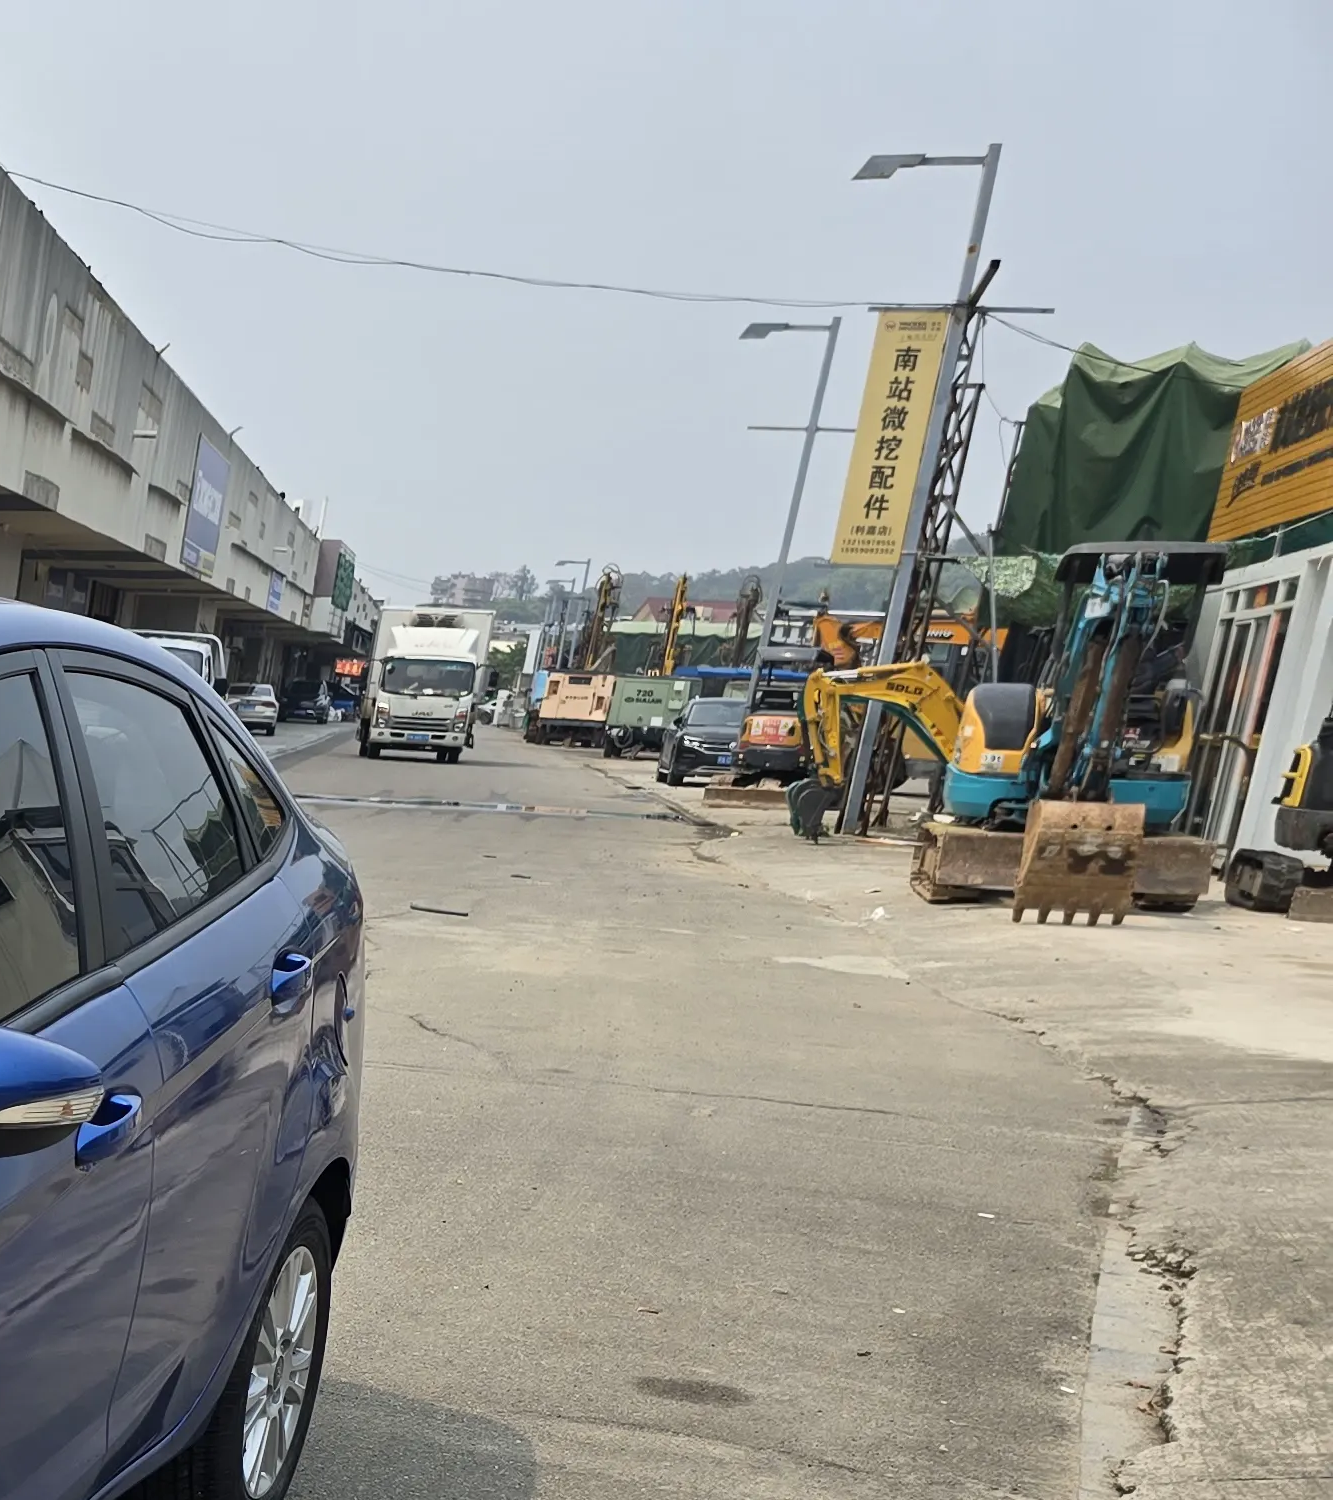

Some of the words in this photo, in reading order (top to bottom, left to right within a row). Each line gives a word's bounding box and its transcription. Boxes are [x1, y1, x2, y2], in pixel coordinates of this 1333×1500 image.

[863, 346, 922, 521] 南站微挖配件
